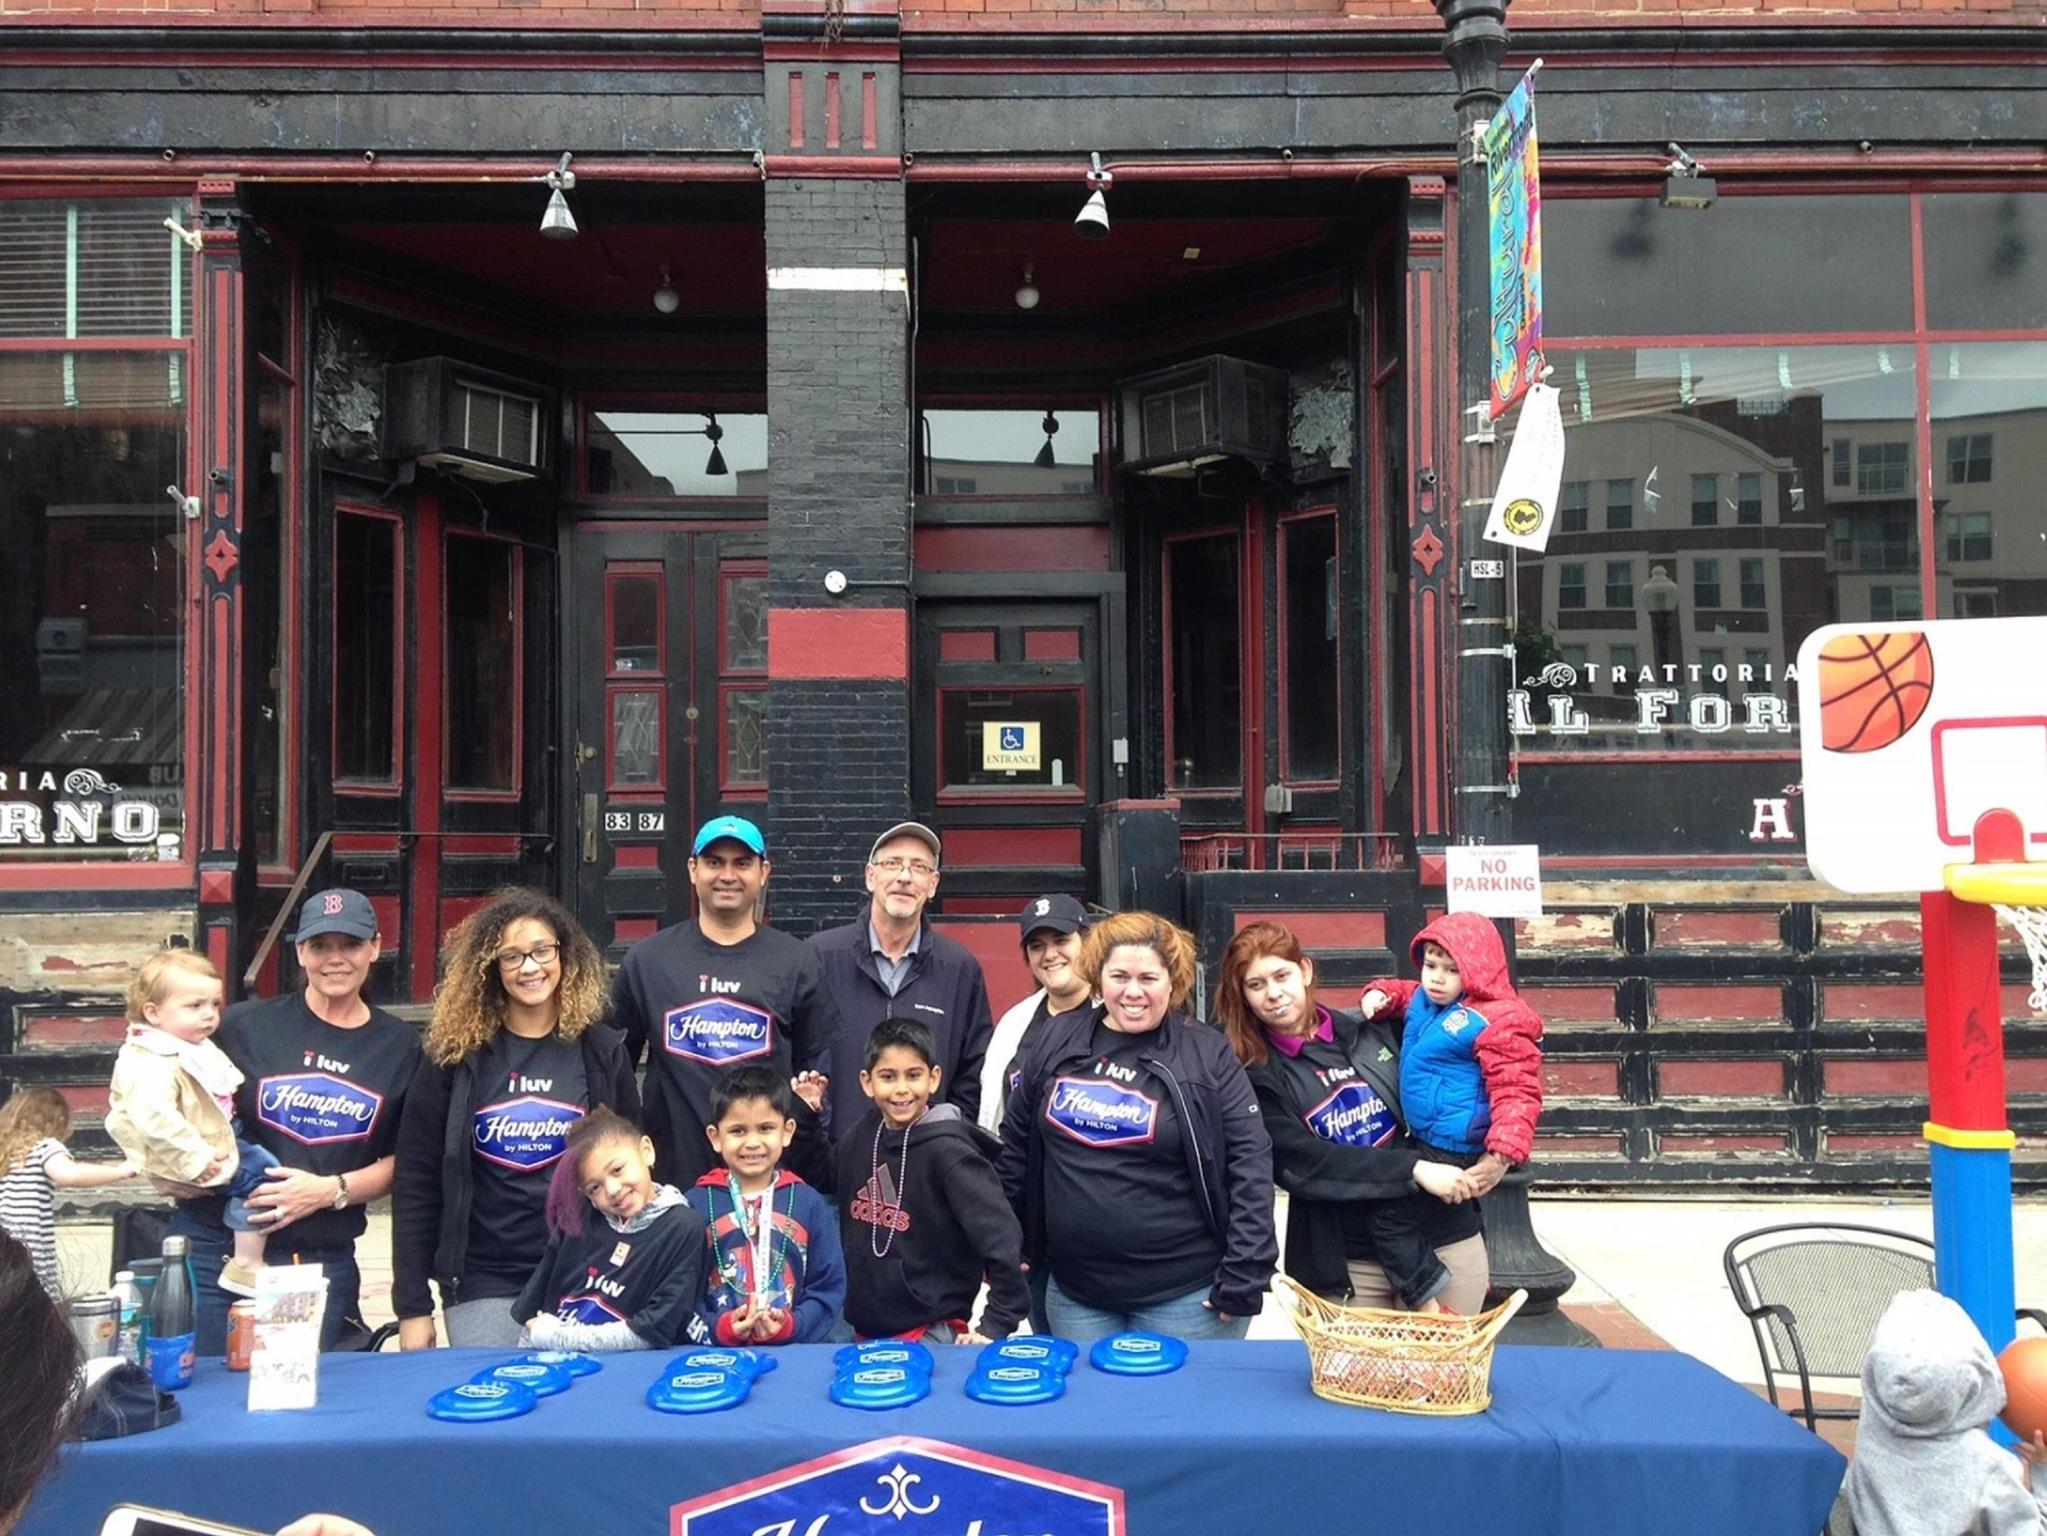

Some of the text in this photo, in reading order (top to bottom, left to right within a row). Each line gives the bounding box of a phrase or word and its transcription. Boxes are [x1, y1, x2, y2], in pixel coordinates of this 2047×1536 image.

[1491, 172, 1519, 401] Cultural
[1634, 688, 1792, 734] FOR
[986, 754, 1037, 764] ENTRANCE
[0, 801, 159, 843] RNO
[606, 814, 662, 829] 83 87
[1480, 859, 1507, 873] NO
[1453, 877, 1536, 891] PARKING
[323, 894, 343, 915] B
[1035, 899, 1050, 917] B
[699, 974, 741, 993] i luv
[670, 1014, 766, 1041] Hampton
[697, 1041, 706, 1049] by
[303, 1050, 350, 1074] i luv
[1094, 1056, 1137, 1081] i luv
[508, 1072, 553, 1093] i luv
[1316, 1067, 1355, 1087] i luv
[262, 1084, 374, 1121] Hampton
[1053, 1087, 1149, 1123] Hampton
[290, 1115, 338, 1128] by HILTON
[1074, 1118, 1118, 1131] by HILTON
[1315, 1096, 1387, 1139] Hampto
[1355, 1121, 1383, 1137] HILTON
[504, 1143, 552, 1153] by HILTON
[850, 1199, 910, 1232] adidas
[594, 1275, 626, 1298] luv
